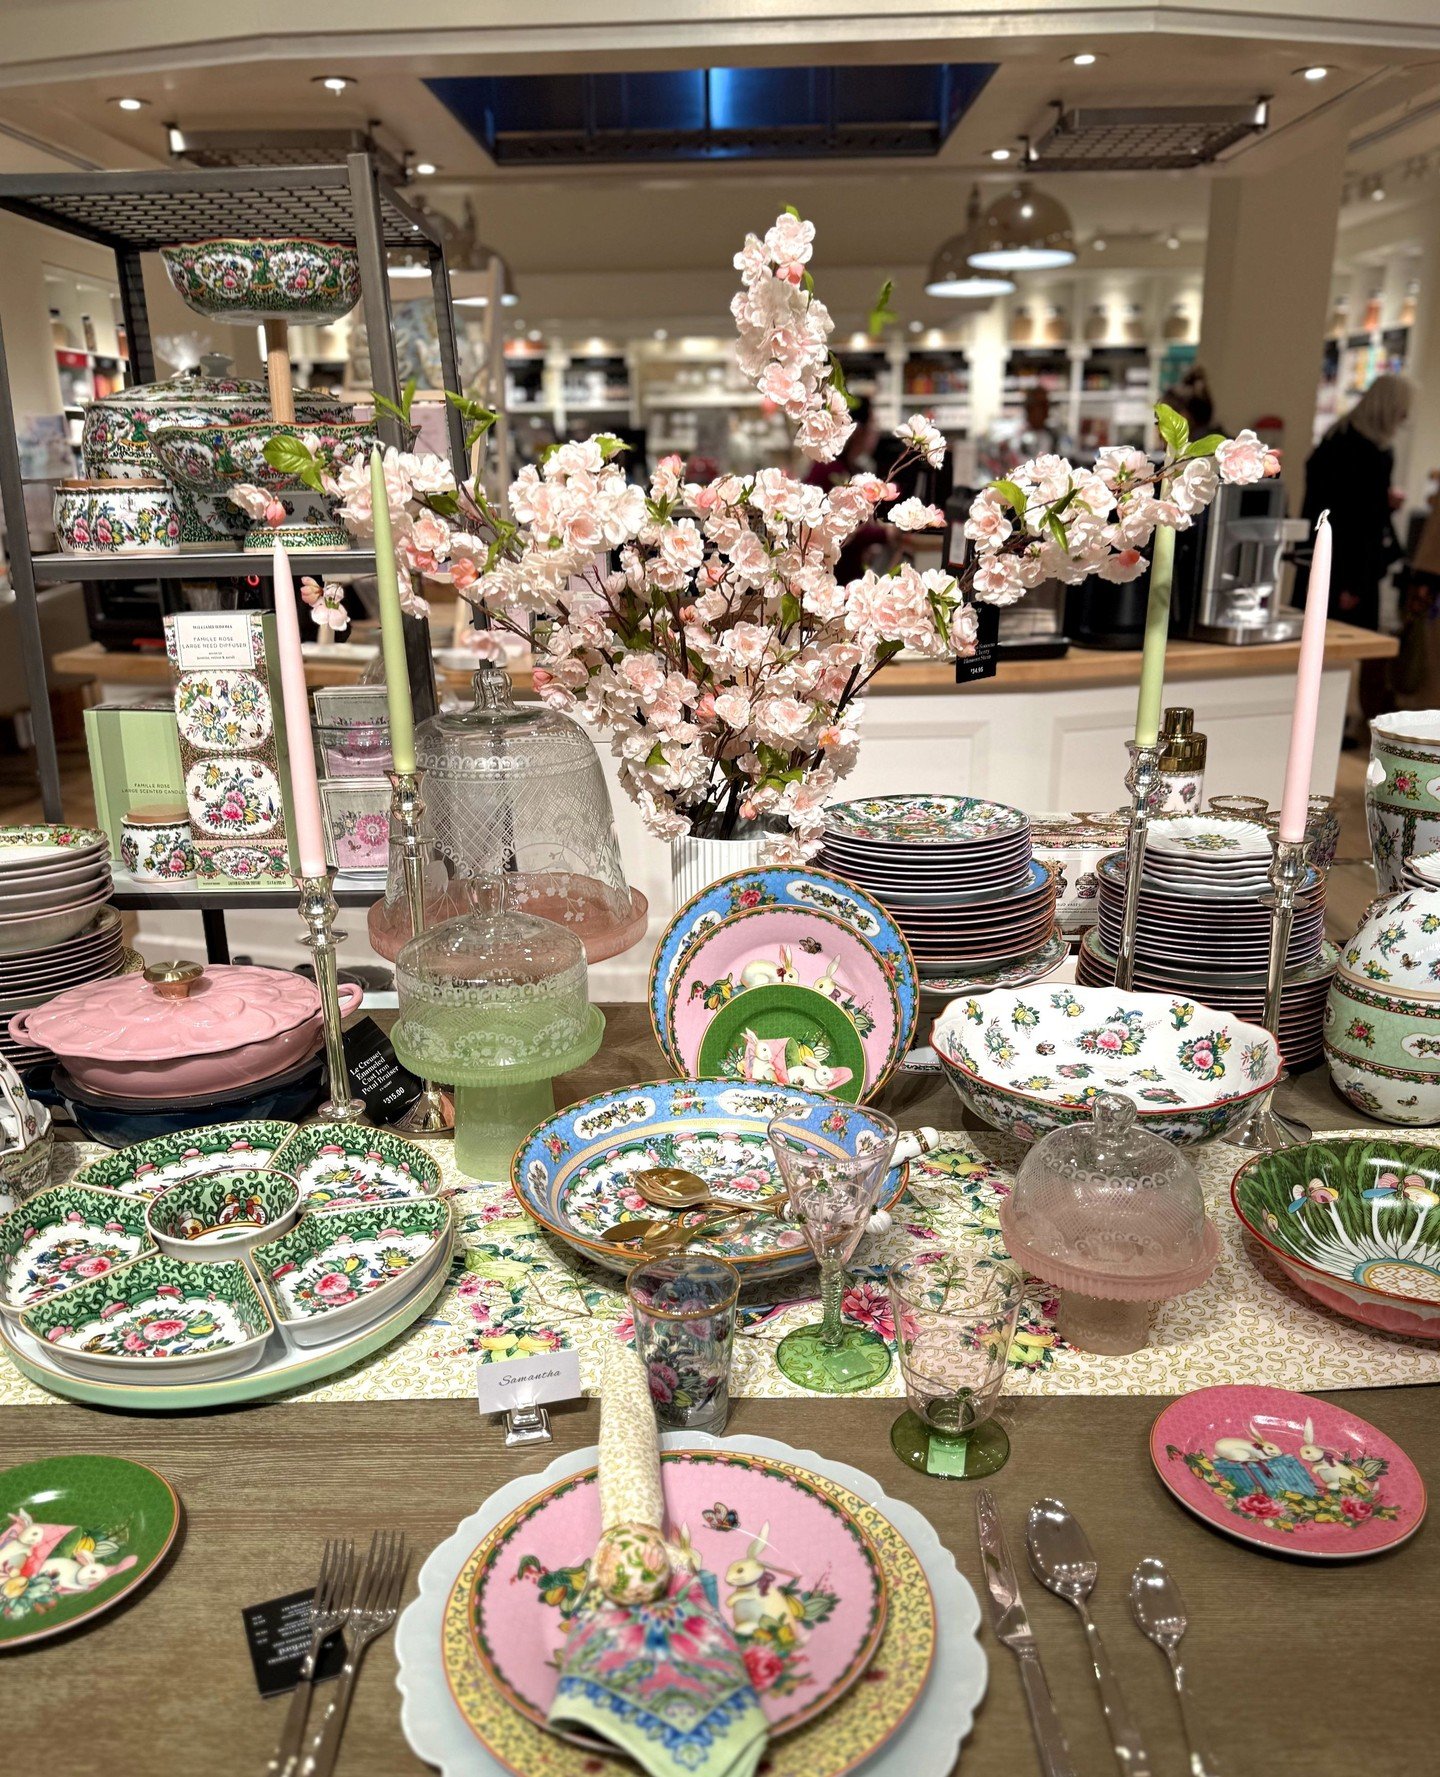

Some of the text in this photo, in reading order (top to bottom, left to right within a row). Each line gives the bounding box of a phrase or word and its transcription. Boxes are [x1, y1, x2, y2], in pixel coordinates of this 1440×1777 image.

[350, 1051, 381, 1075] Le Creuset
[355, 1056, 386, 1081] Enameled
[361, 1064, 390, 1085] Cast Iron
[361, 1079, 379, 1095] Petal
[377, 1065, 399, 1084] Braiser
[382, 1086, 405, 1104] $315.00
[499, 1369, 561, 1387] Samantha
